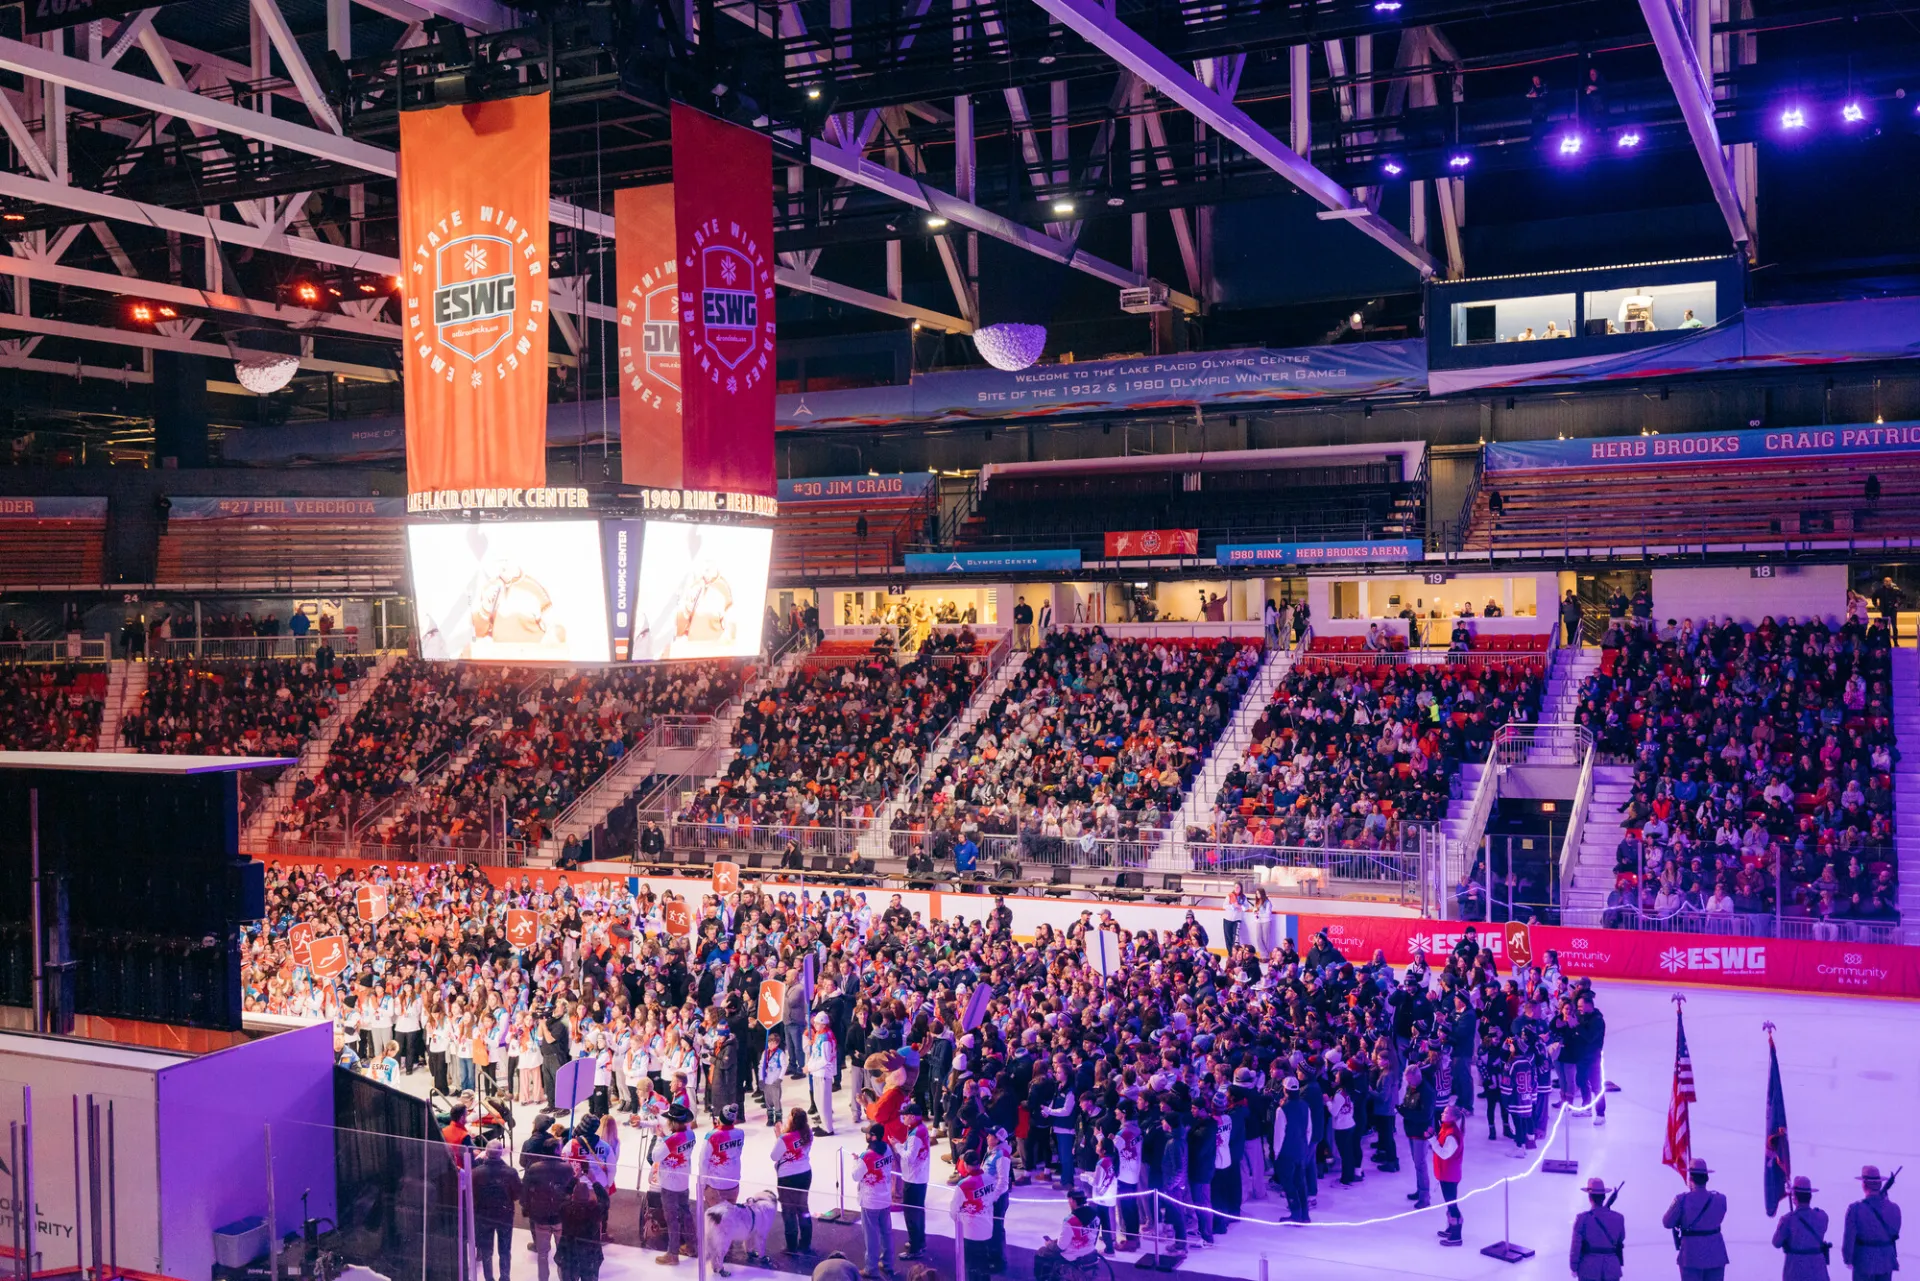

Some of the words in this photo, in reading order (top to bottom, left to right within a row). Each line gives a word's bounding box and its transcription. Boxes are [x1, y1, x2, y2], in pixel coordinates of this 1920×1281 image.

[413, 210, 463, 275] STATE
[480, 205, 542, 277] WINTER
[731, 221, 774, 300] WINTER
[435, 277, 515, 324] ESWG
[703, 292, 757, 327] ESWG
[408, 297, 455, 382] EMPIRE
[496, 300, 543, 380] GAMES
[1015, 373, 1070, 383] WELCOME
[1074, 371, 1089, 379] TO
[1093, 369, 1115, 377] THE
[1120, 366, 1150, 376] LAKE
[1154, 362, 1197, 373] PLACID
[1202, 358, 1255, 369] OLYMPIC
[1260, 355, 1310, 365] CENTER
[978, 391, 1006, 401] SITE
[1011, 391, 1027, 400] OF
[1032, 388, 1056, 398] THE
[1063, 385, 1101, 397] 1932
[1107, 383, 1117, 393] &
[1125, 379, 1164, 391] 1980
[1170, 375, 1230, 388] OLYMPIC
[1235, 371, 1289, 383] WINTER
[1295, 368, 1347, 380] GAMES
[1591, 440, 1647, 459] HERB
[1653, 435, 1741, 457] BROOKS
[1765, 430, 1835, 451] CRAIG
[423, 489, 459, 510] PLACID
[461, 488, 522, 508] OLYMPIC
[525, 487, 589, 508] CENTER
[793, 482, 822, 496] #30
[826, 480, 853, 495] JIM
[857, 478, 903, 493] CRAIG
[219, 500, 249, 514] #27
[252, 500, 289, 513] PHIL
[295, 500, 376, 513] VERCHOTA
[641, 489, 681, 509] 1980
[683, 490, 718, 510] RINK
[726, 492, 753, 512] HERB
[618, 530, 628, 568] CENTER
[1230, 550, 1254, 560] 1980
[1256, 549, 1283, 559] RINK
[1296, 548, 1324, 558] HERB
[1326, 547, 1368, 557] BROOKS
[1371, 546, 1409, 556] ARENA
[1428, 573, 1442, 584] 19
[1754, 566, 1771, 577] 18
[124, 594, 139, 603] 24
[618, 569, 627, 610] OLYMPIC
[892, 585, 903, 595] 21
[1557, 950, 1611, 963] ommunity
[1567, 961, 1595, 969] BANK
[1687, 947, 1766, 970] ESWG
[1817, 964, 1888, 980] Community
[1838, 977, 1869, 985] BANK
[719, 1138, 742, 1152] ESWG
